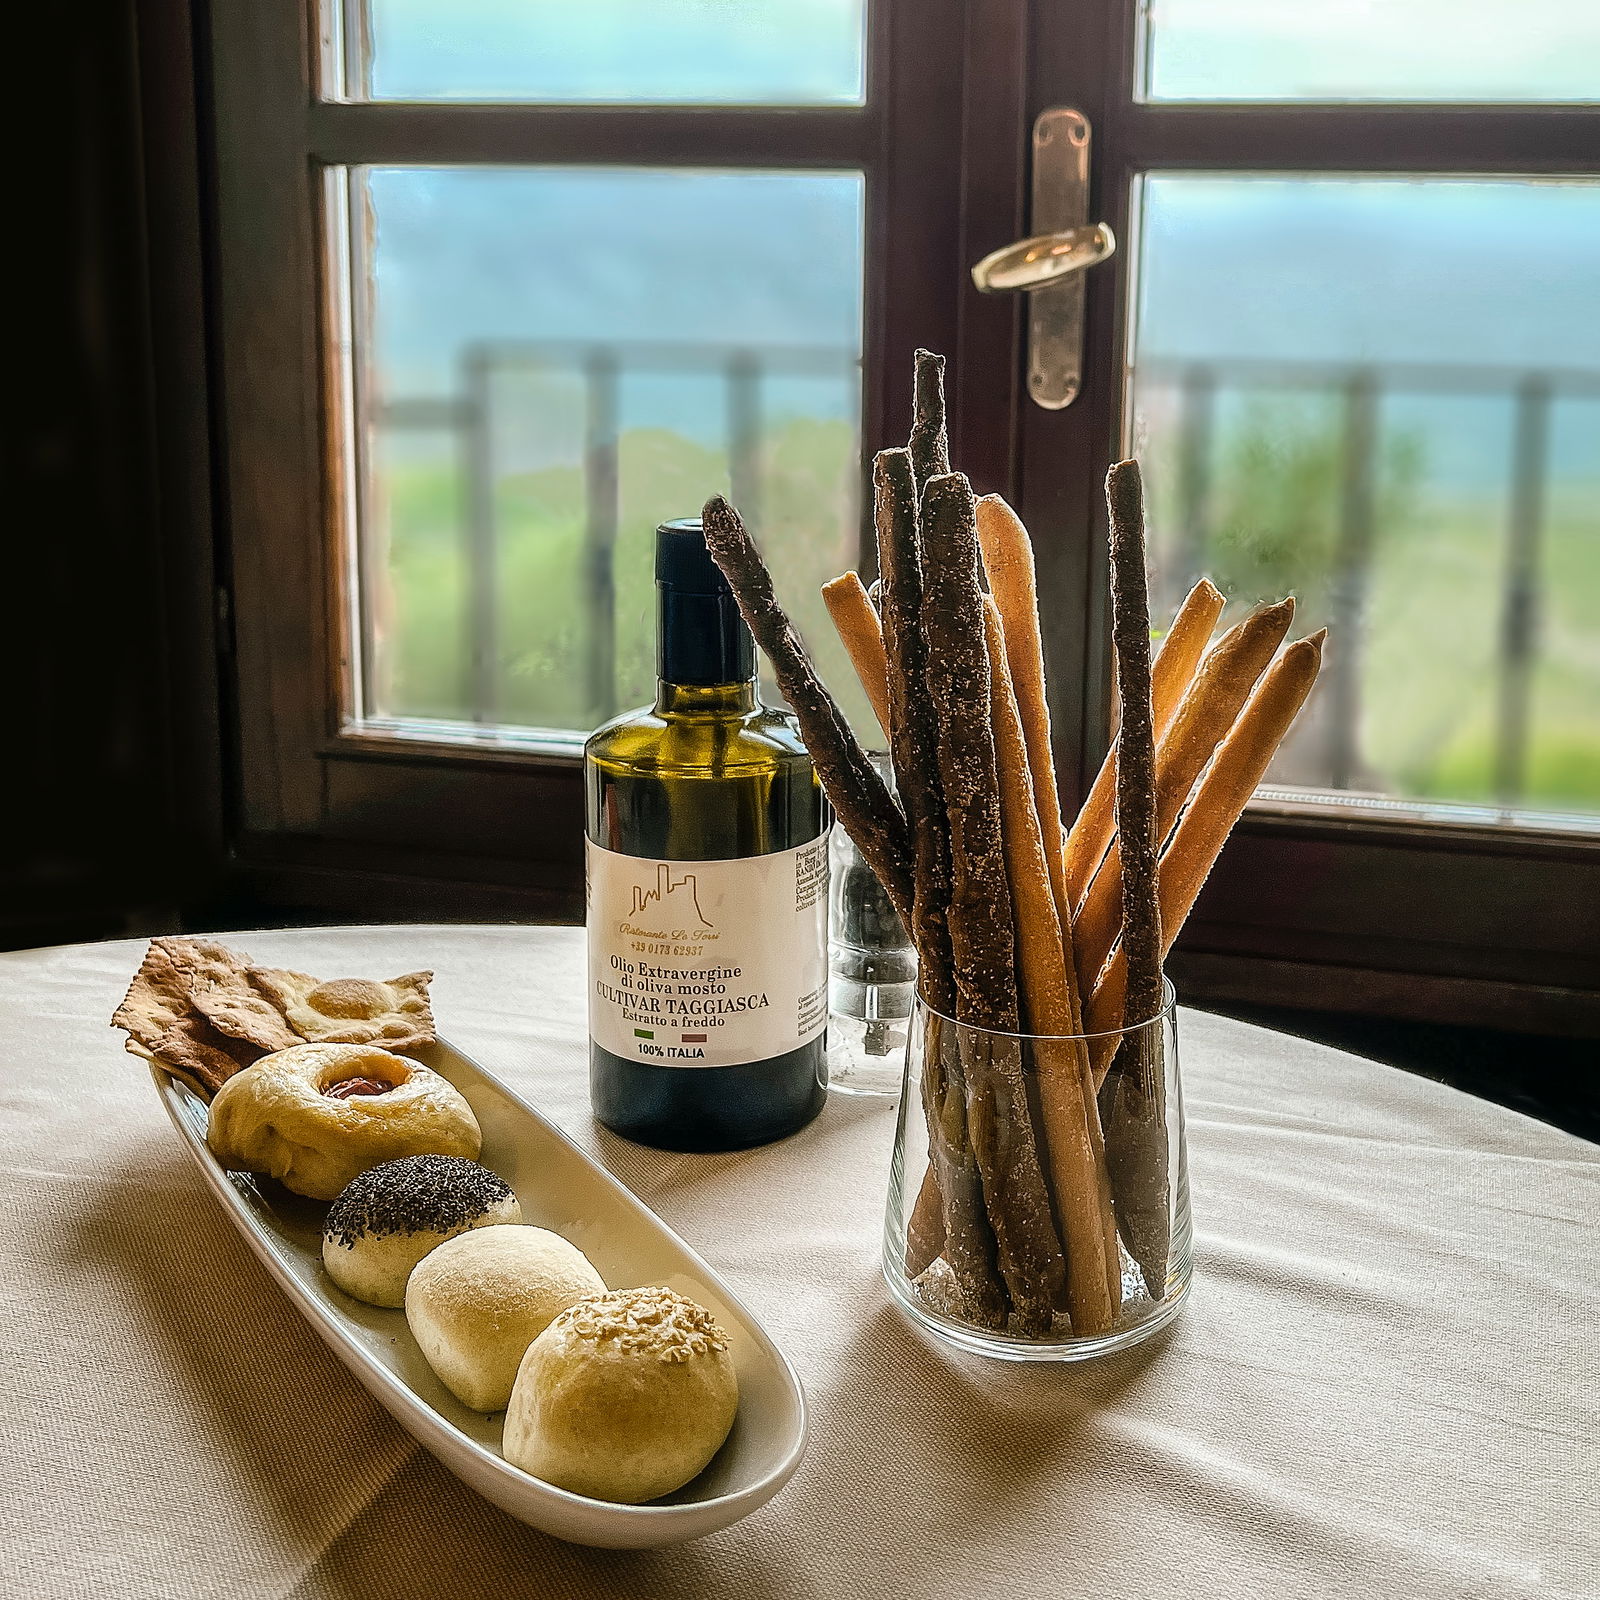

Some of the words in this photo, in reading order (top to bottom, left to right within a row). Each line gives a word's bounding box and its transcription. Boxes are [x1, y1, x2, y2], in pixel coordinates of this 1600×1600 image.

[630, 941, 646, 953] +39
[648, 943, 671, 955] 0173
[673, 945, 704, 956] 62937
[610, 954, 635, 974] Olio
[638, 960, 742, 983] Extravergine
[621, 974, 633, 988] di
[637, 979, 673, 994] oliva
[678, 982, 726, 995] mosto
[596, 980, 661, 1013] CULTIVAR
[665, 992, 770, 1015] TAGGIASCA
[622, 1007, 667, 1027] Estratto
[671, 1018, 678, 1027] a
[682, 1015, 725, 1028] freddo
[638, 1043, 664, 1057] 100%
[667, 1047, 705, 1059] ITALIA
